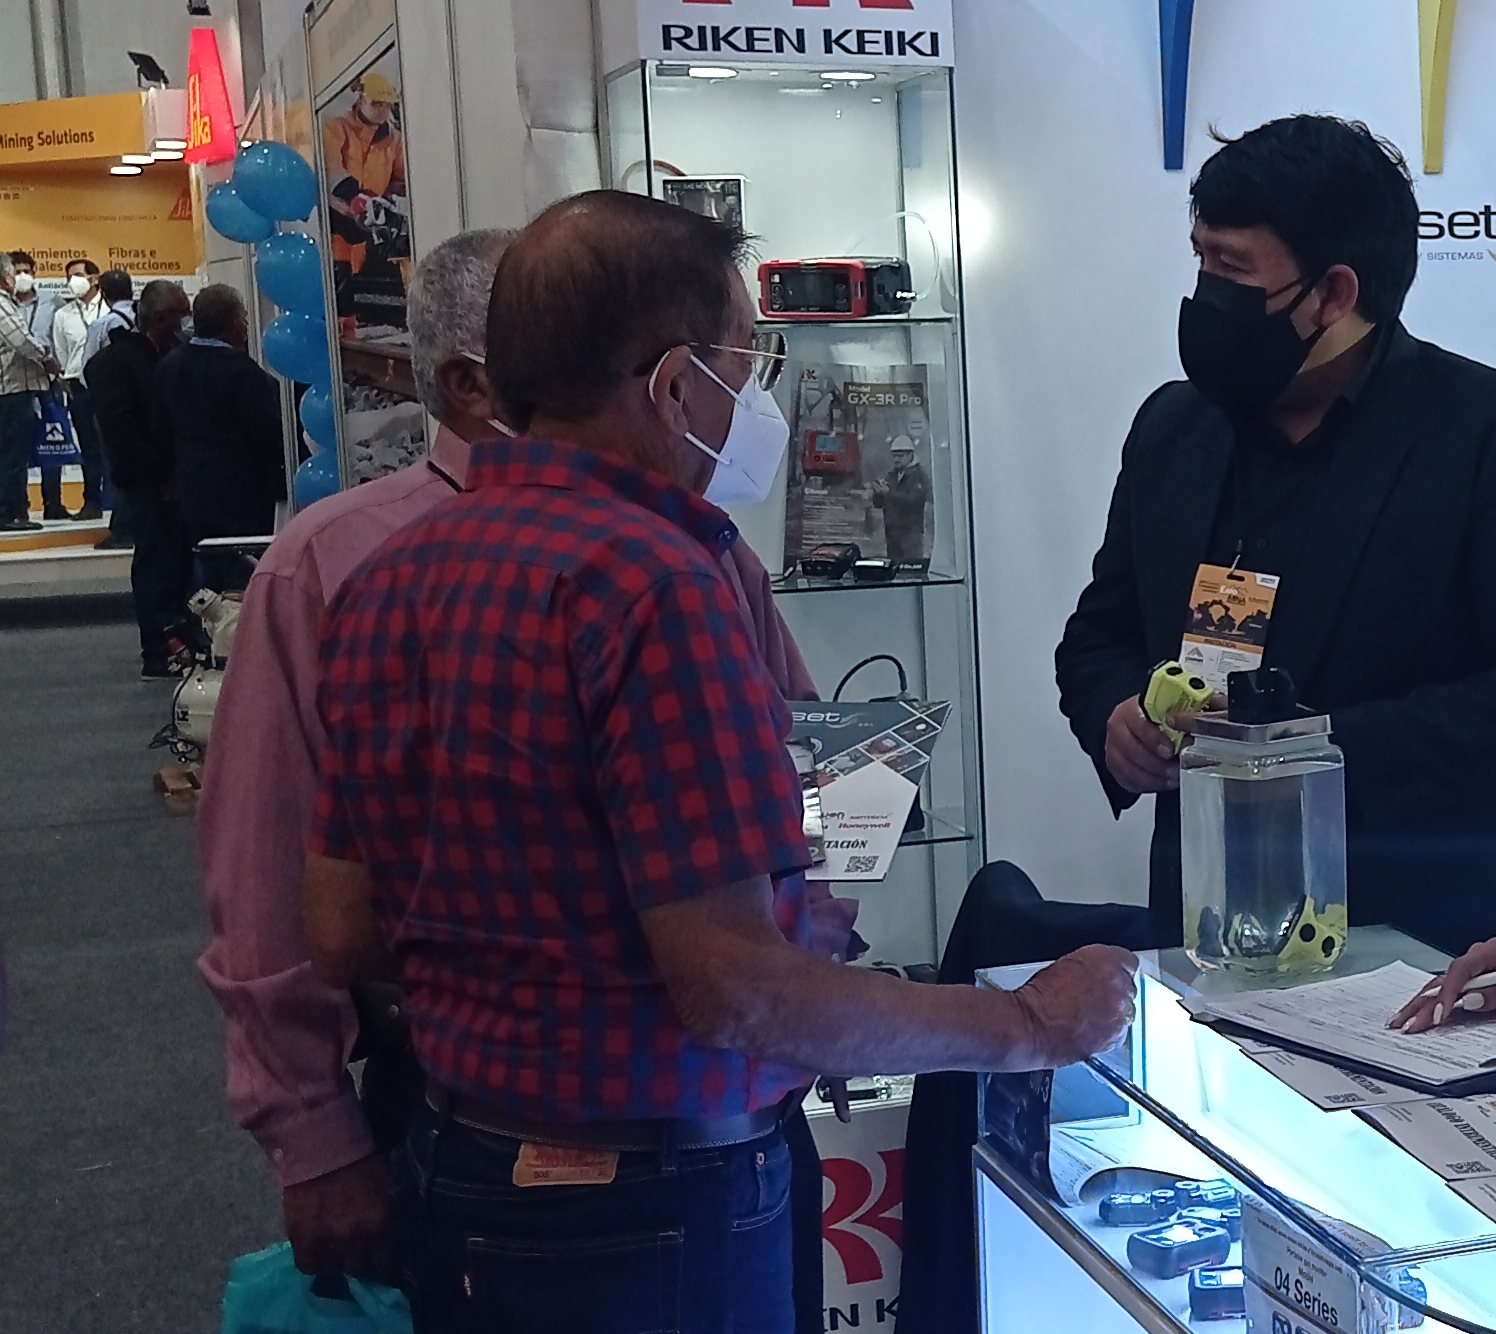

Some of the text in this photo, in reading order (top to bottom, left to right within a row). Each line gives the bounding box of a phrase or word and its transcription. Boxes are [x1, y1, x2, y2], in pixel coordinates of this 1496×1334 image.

[660, 23, 941, 58] RIKEN KEIKI
[37, 128, 95, 147] Solutions
[1426, 252, 1484, 262] SISTEMAS
[847, 394, 922, 406] GX-3R Pro
[792, 711, 841, 723] set
[1274, 1266, 1339, 1327] 04 Series
